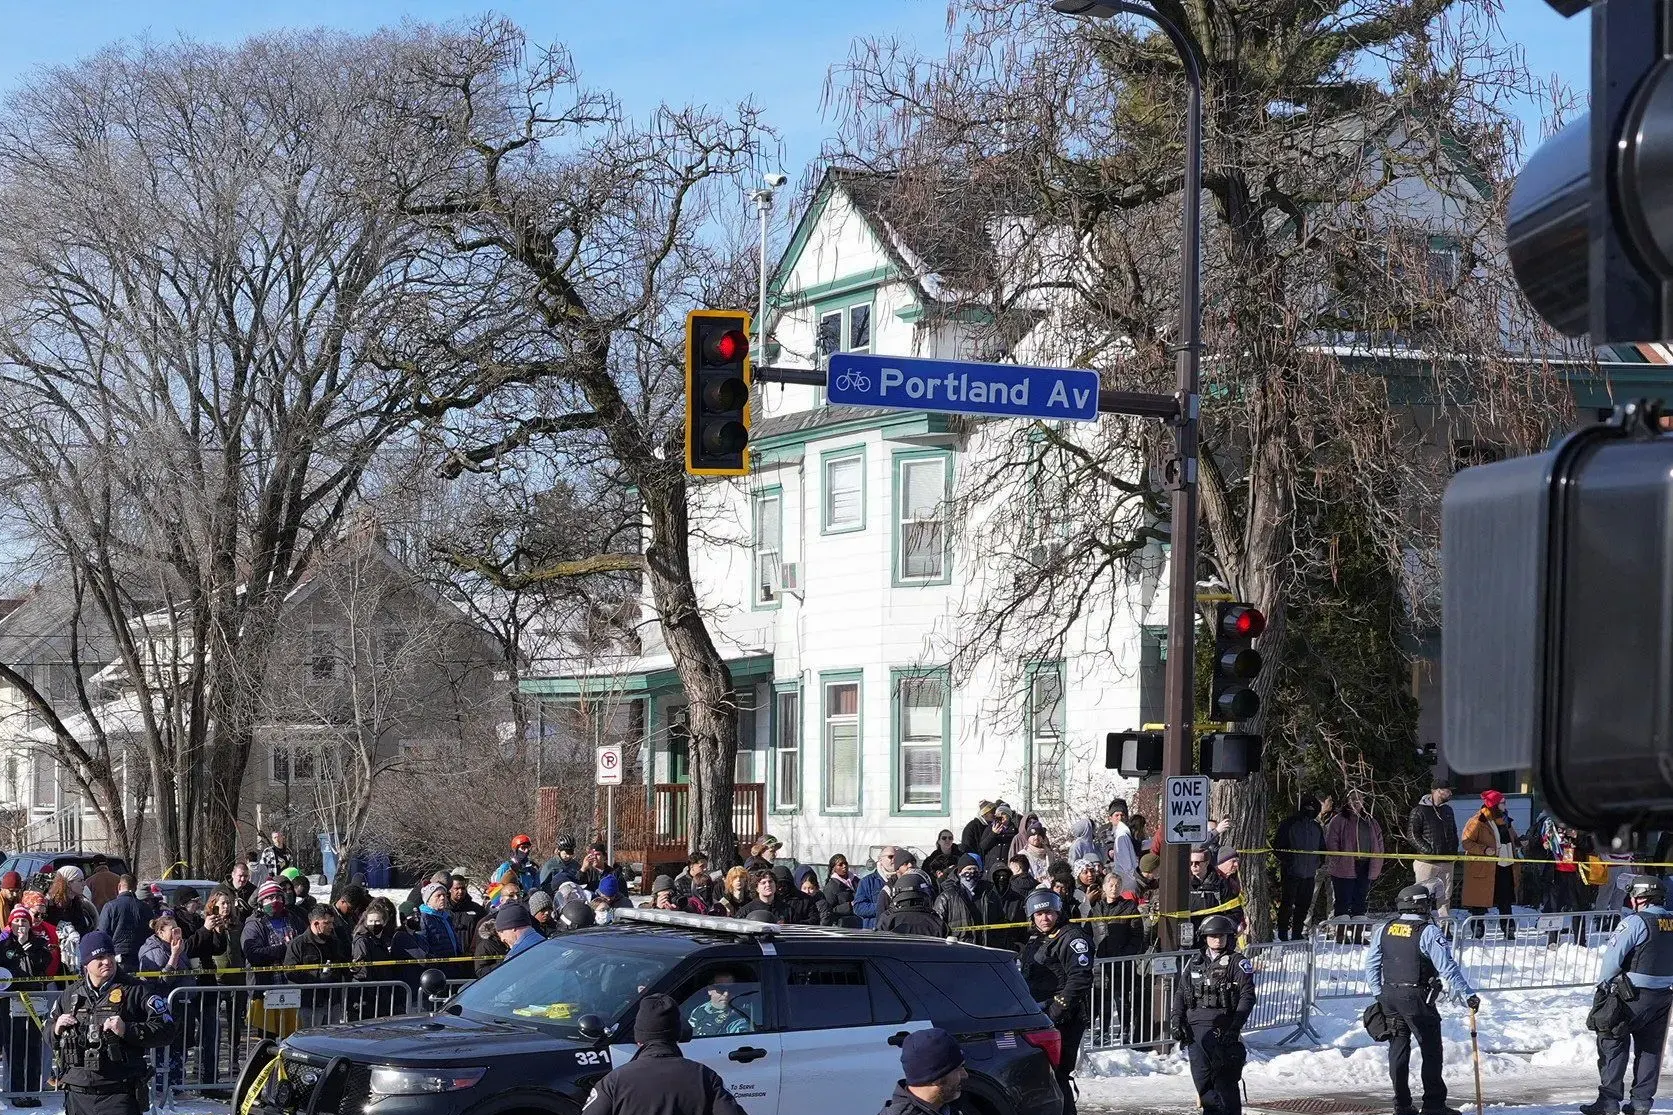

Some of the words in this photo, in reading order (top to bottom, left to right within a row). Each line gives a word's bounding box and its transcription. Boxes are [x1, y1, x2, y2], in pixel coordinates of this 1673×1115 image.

[880, 367, 1030, 406] Portland
[1047, 380, 1091, 409] Av
[1172, 781, 1202, 797] ONE
[1171, 800, 1202, 816] WAY
[1388, 923, 1413, 937] POLICE
[575, 1050, 611, 1066] 321
